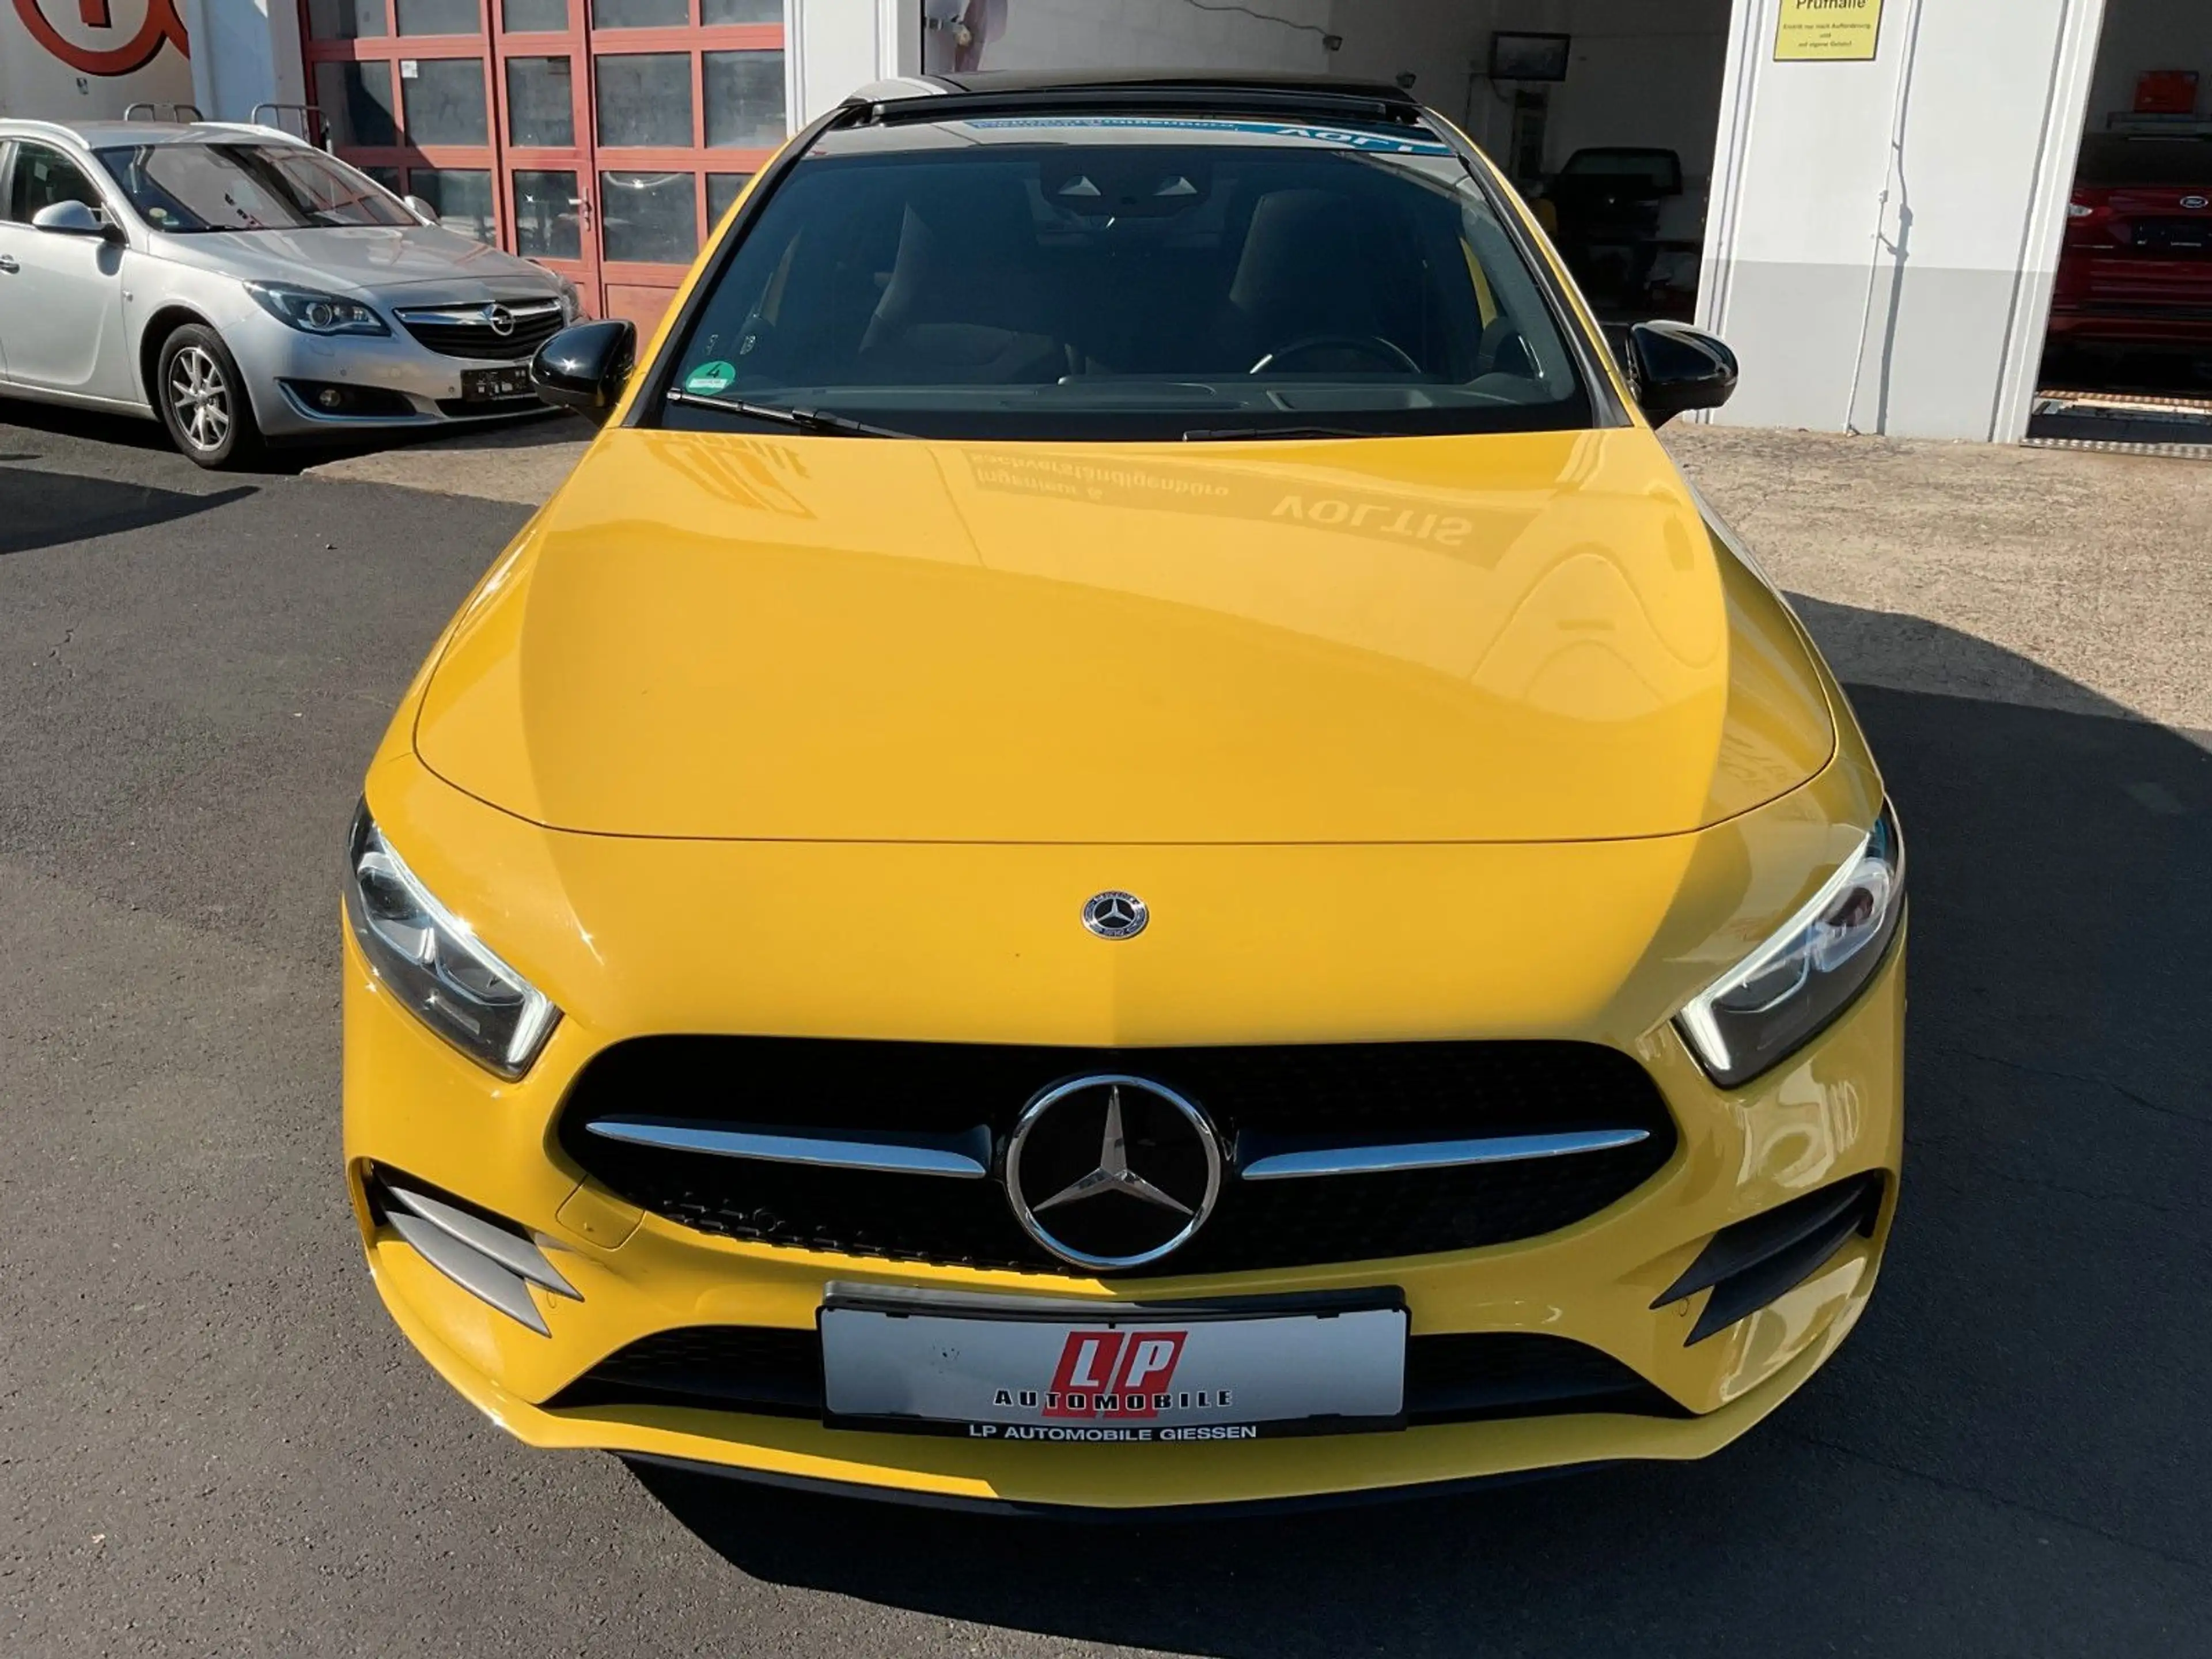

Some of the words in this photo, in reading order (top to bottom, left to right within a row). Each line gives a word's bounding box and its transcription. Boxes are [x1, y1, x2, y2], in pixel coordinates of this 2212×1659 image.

[706, 363, 722, 378] 4
[1069, 1339, 1175, 1388] LP
[993, 1389, 1233, 1411] AUTOMOBILE
[969, 1425, 997, 1438] LP
[1004, 1426, 1153, 1441] AUTOMOBILE
[1159, 1426, 1257, 1440] GIESSEN
